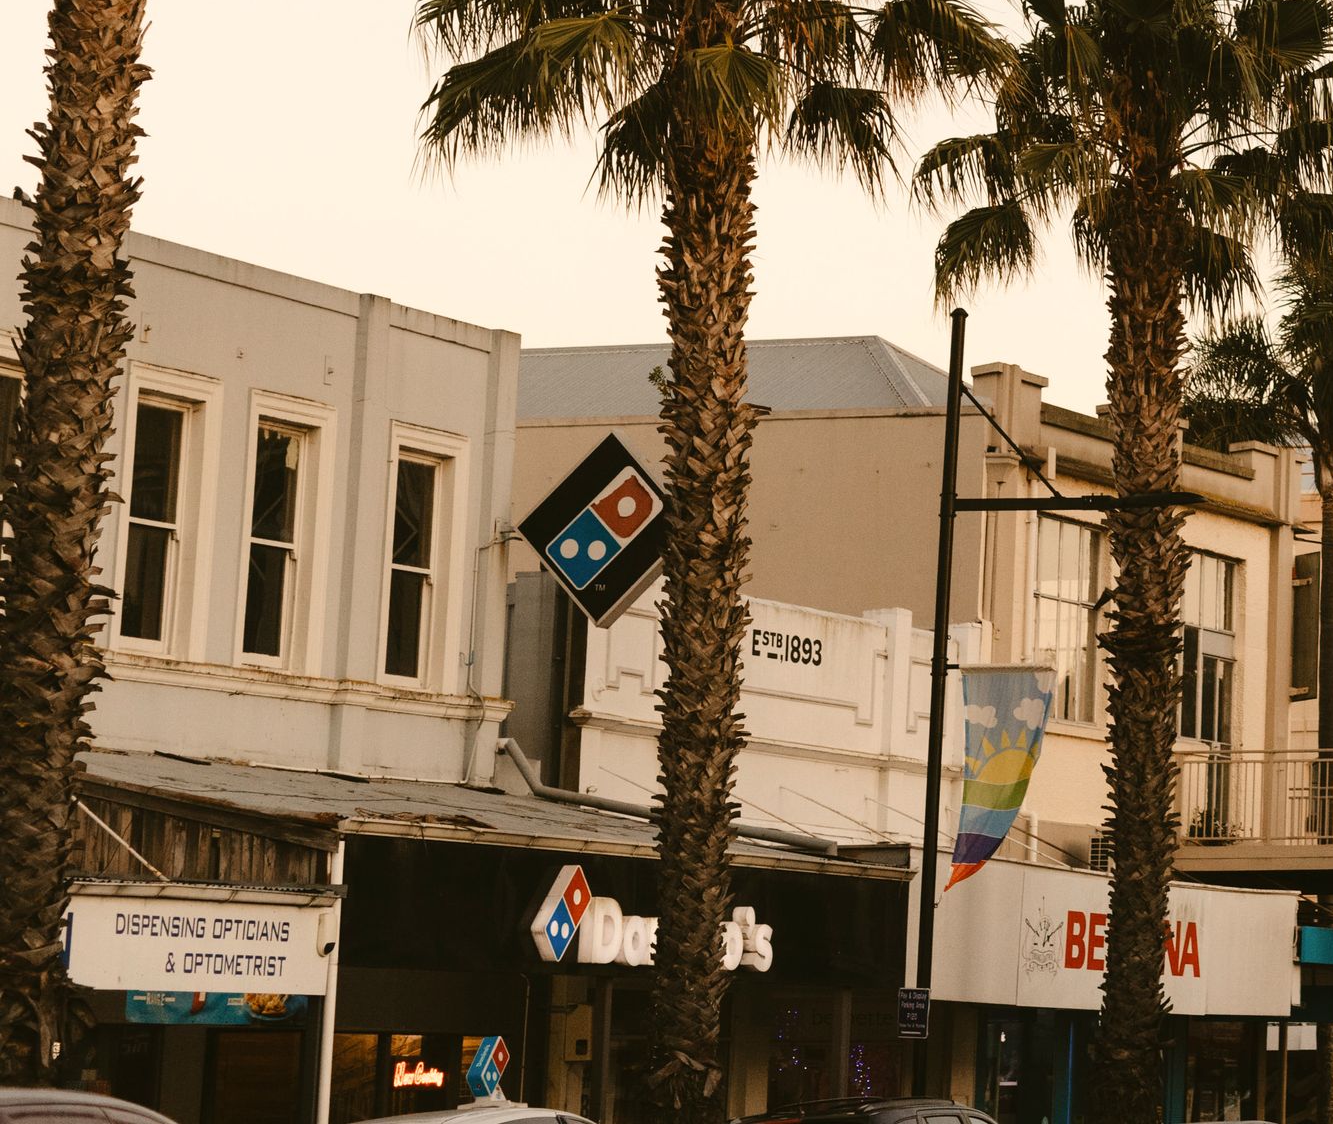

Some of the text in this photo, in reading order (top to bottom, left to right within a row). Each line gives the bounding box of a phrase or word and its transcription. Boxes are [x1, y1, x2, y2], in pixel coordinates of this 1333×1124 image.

[785, 634, 822, 666] 1893
[115, 912, 290, 943] DISPENSING OPTICIANS
[578, 896, 773, 972] Doo's
[1064, 910, 1201, 978] BENA
[165, 952, 287, 976] & OPTOMETRIST
